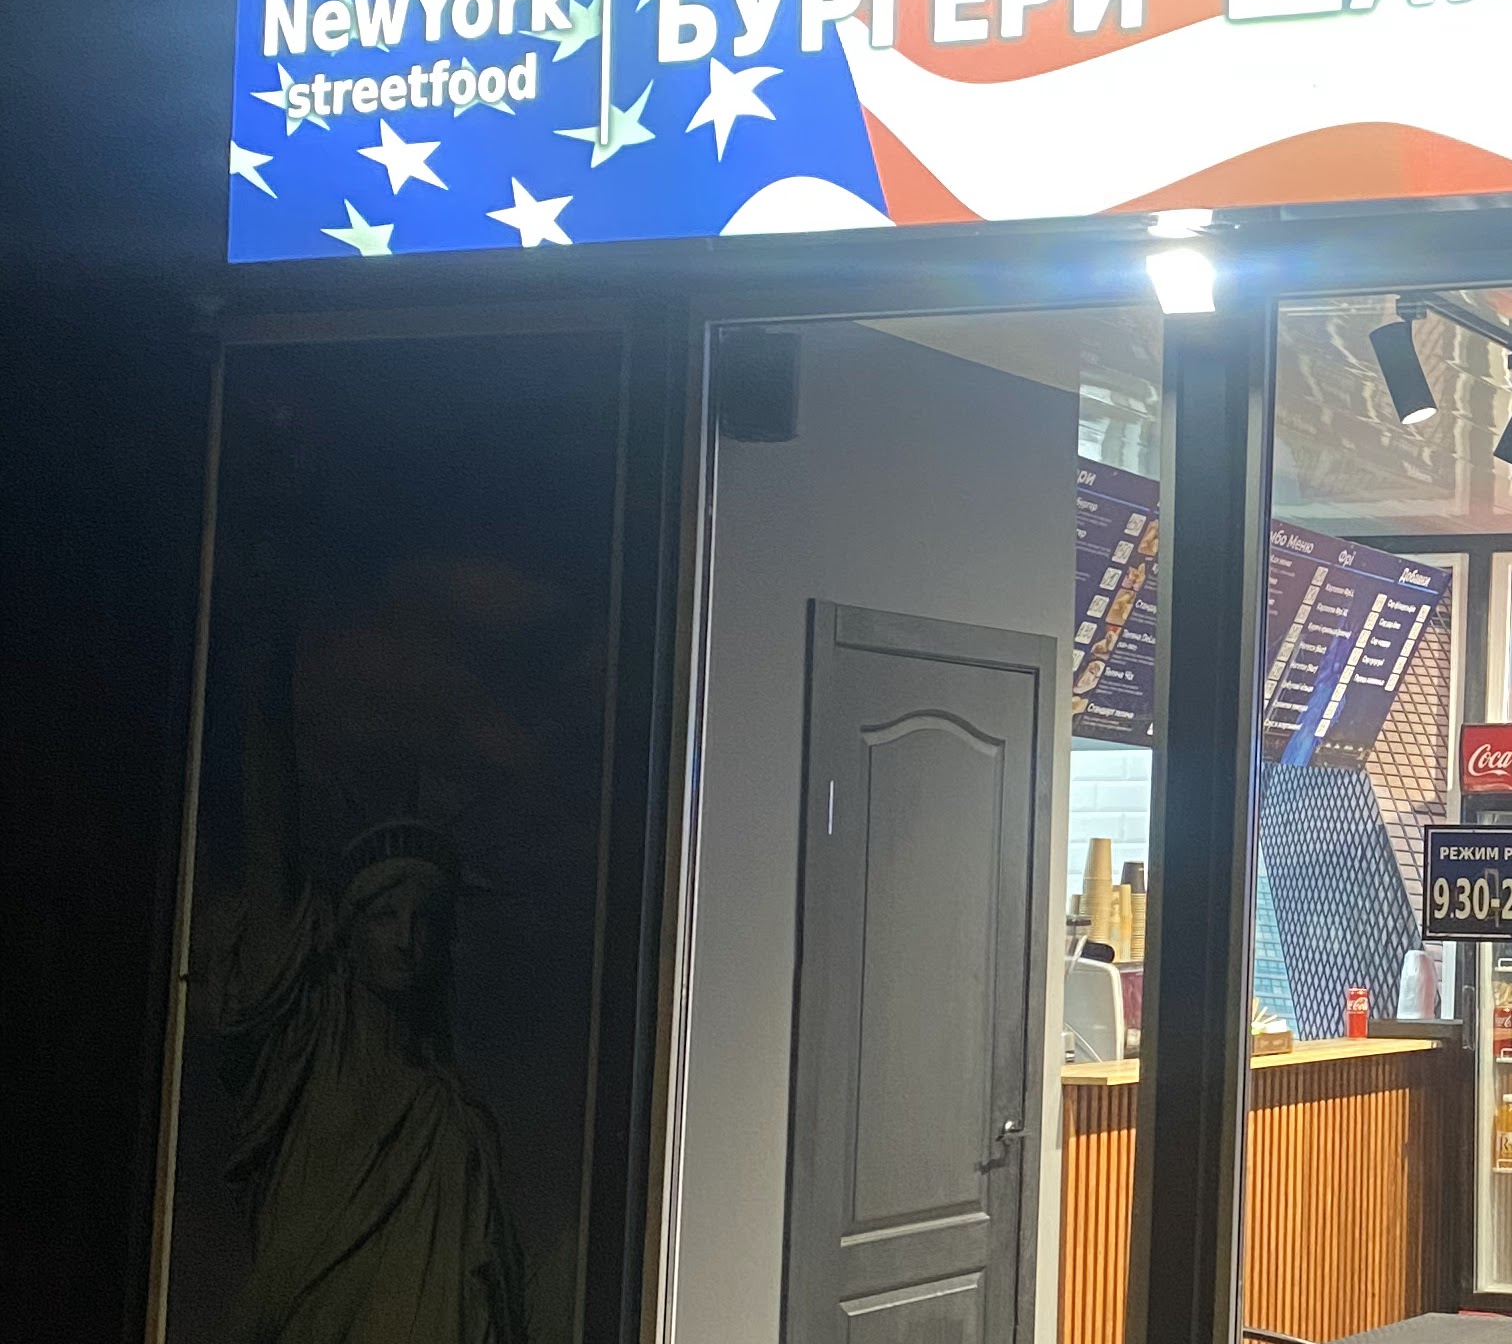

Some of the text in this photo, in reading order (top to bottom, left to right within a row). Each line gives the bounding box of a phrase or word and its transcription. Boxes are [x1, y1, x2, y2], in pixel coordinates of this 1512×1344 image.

[287, 51, 538, 119] streetfood
[1077, 469, 1097, 487] ри
[1270, 530, 1315, 554] мбо Меню
[1338, 549, 1357, 568] Фрі
[1439, 846, 1499, 861] РЕЖИМ
